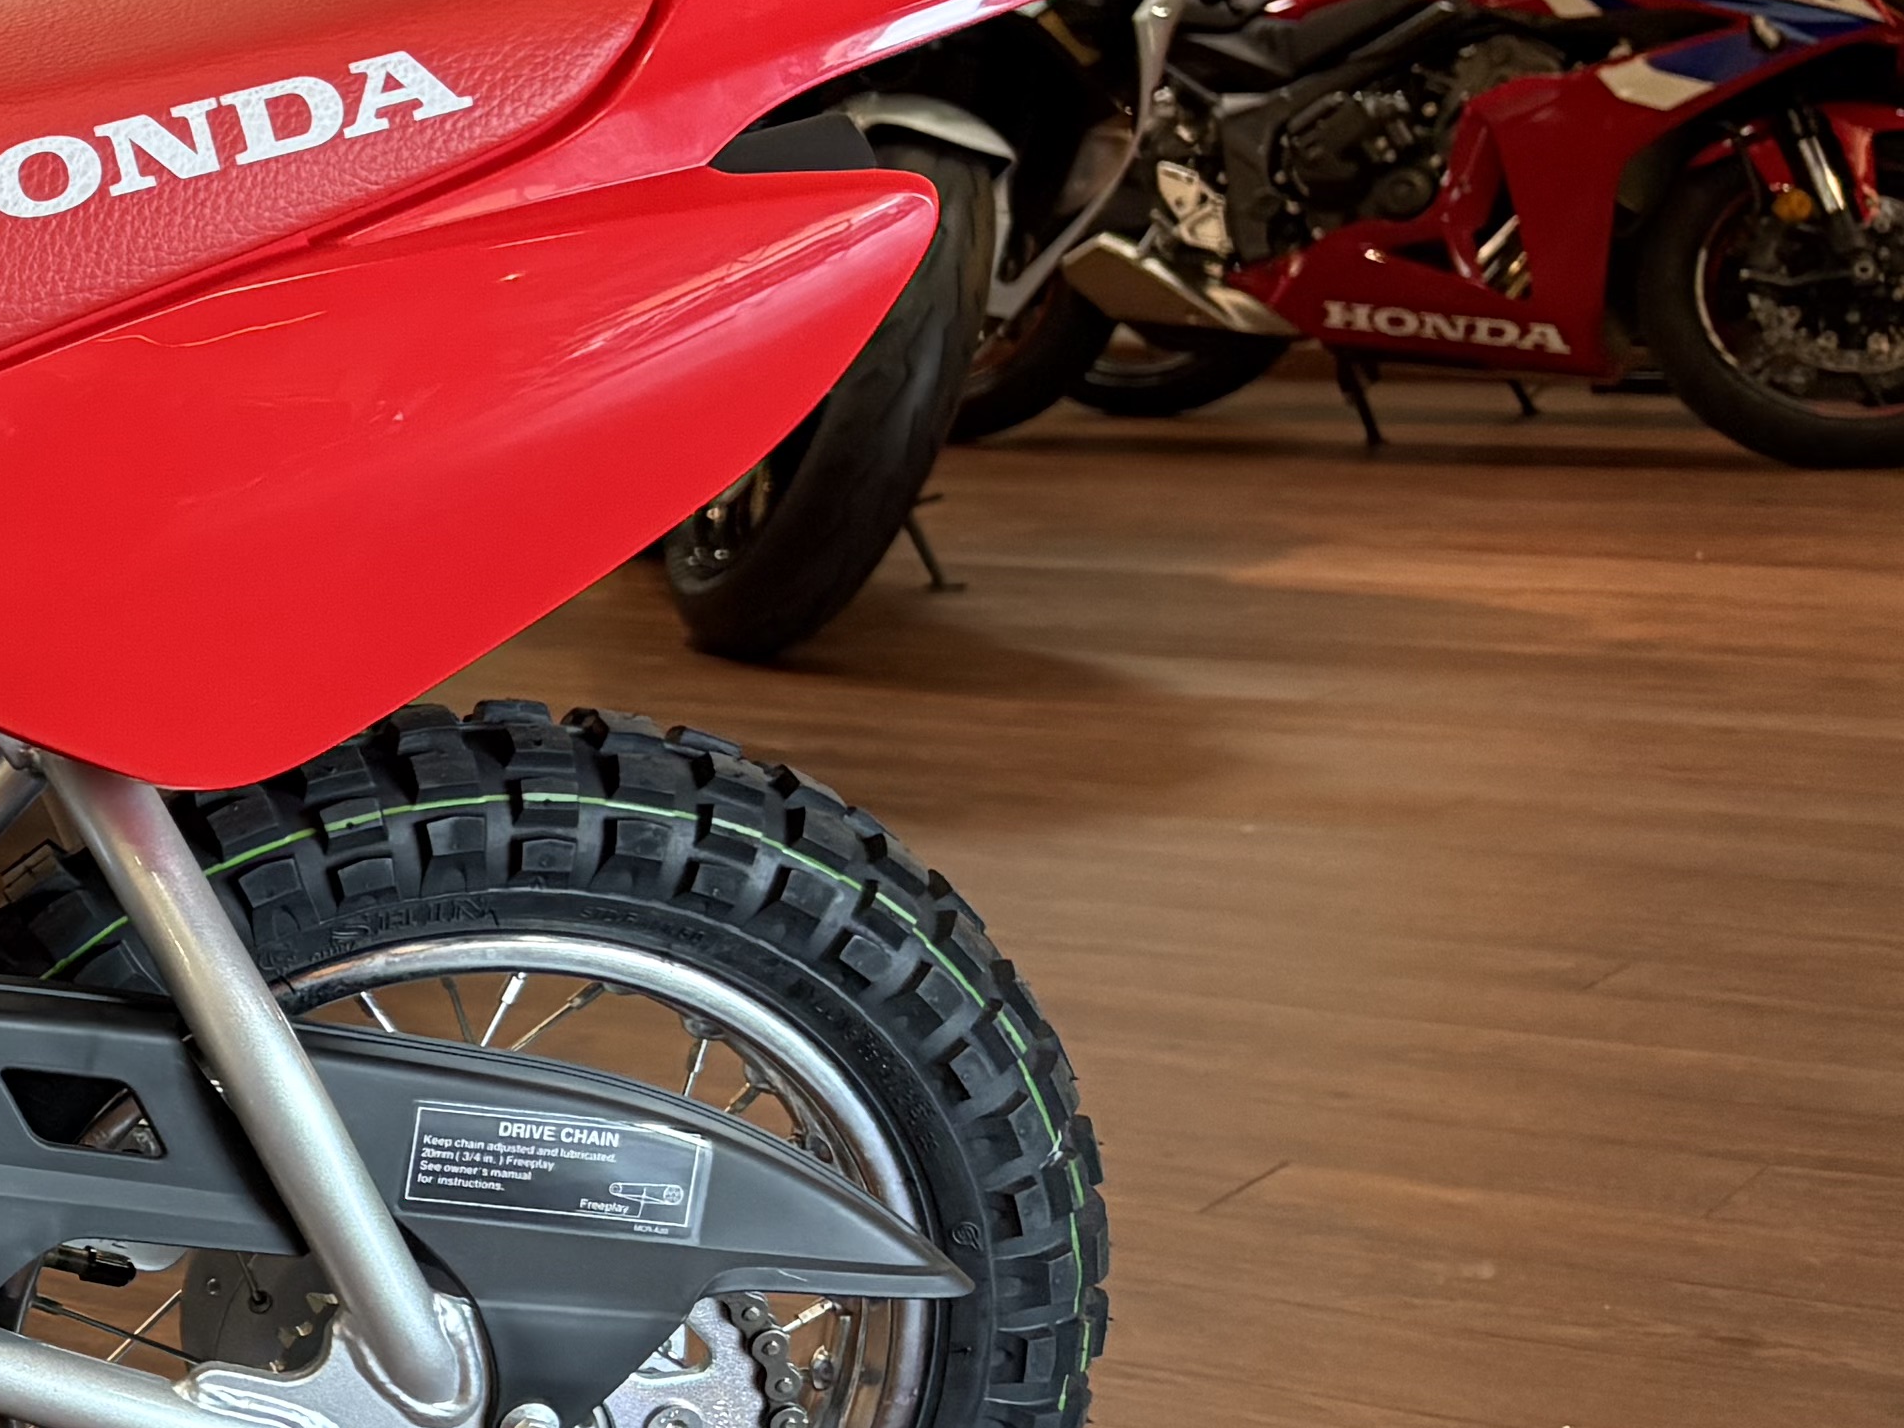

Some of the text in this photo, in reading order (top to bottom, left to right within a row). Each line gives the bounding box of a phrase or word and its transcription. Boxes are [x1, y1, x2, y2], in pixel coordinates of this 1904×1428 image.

[1323, 299, 1570, 355] HONDA
[497, 1121, 620, 1147] DRIVE CHAIN
[420, 1147, 454, 1160] 20mm
[505, 1155, 555, 1172] Freeplay
[422, 1133, 616, 1163] Keep chain adjusted and lubricated.
[416, 1173, 505, 1191] for instructions.
[419, 1160, 532, 1180] See owner's manual
[578, 1198, 630, 1215] Freeplay
